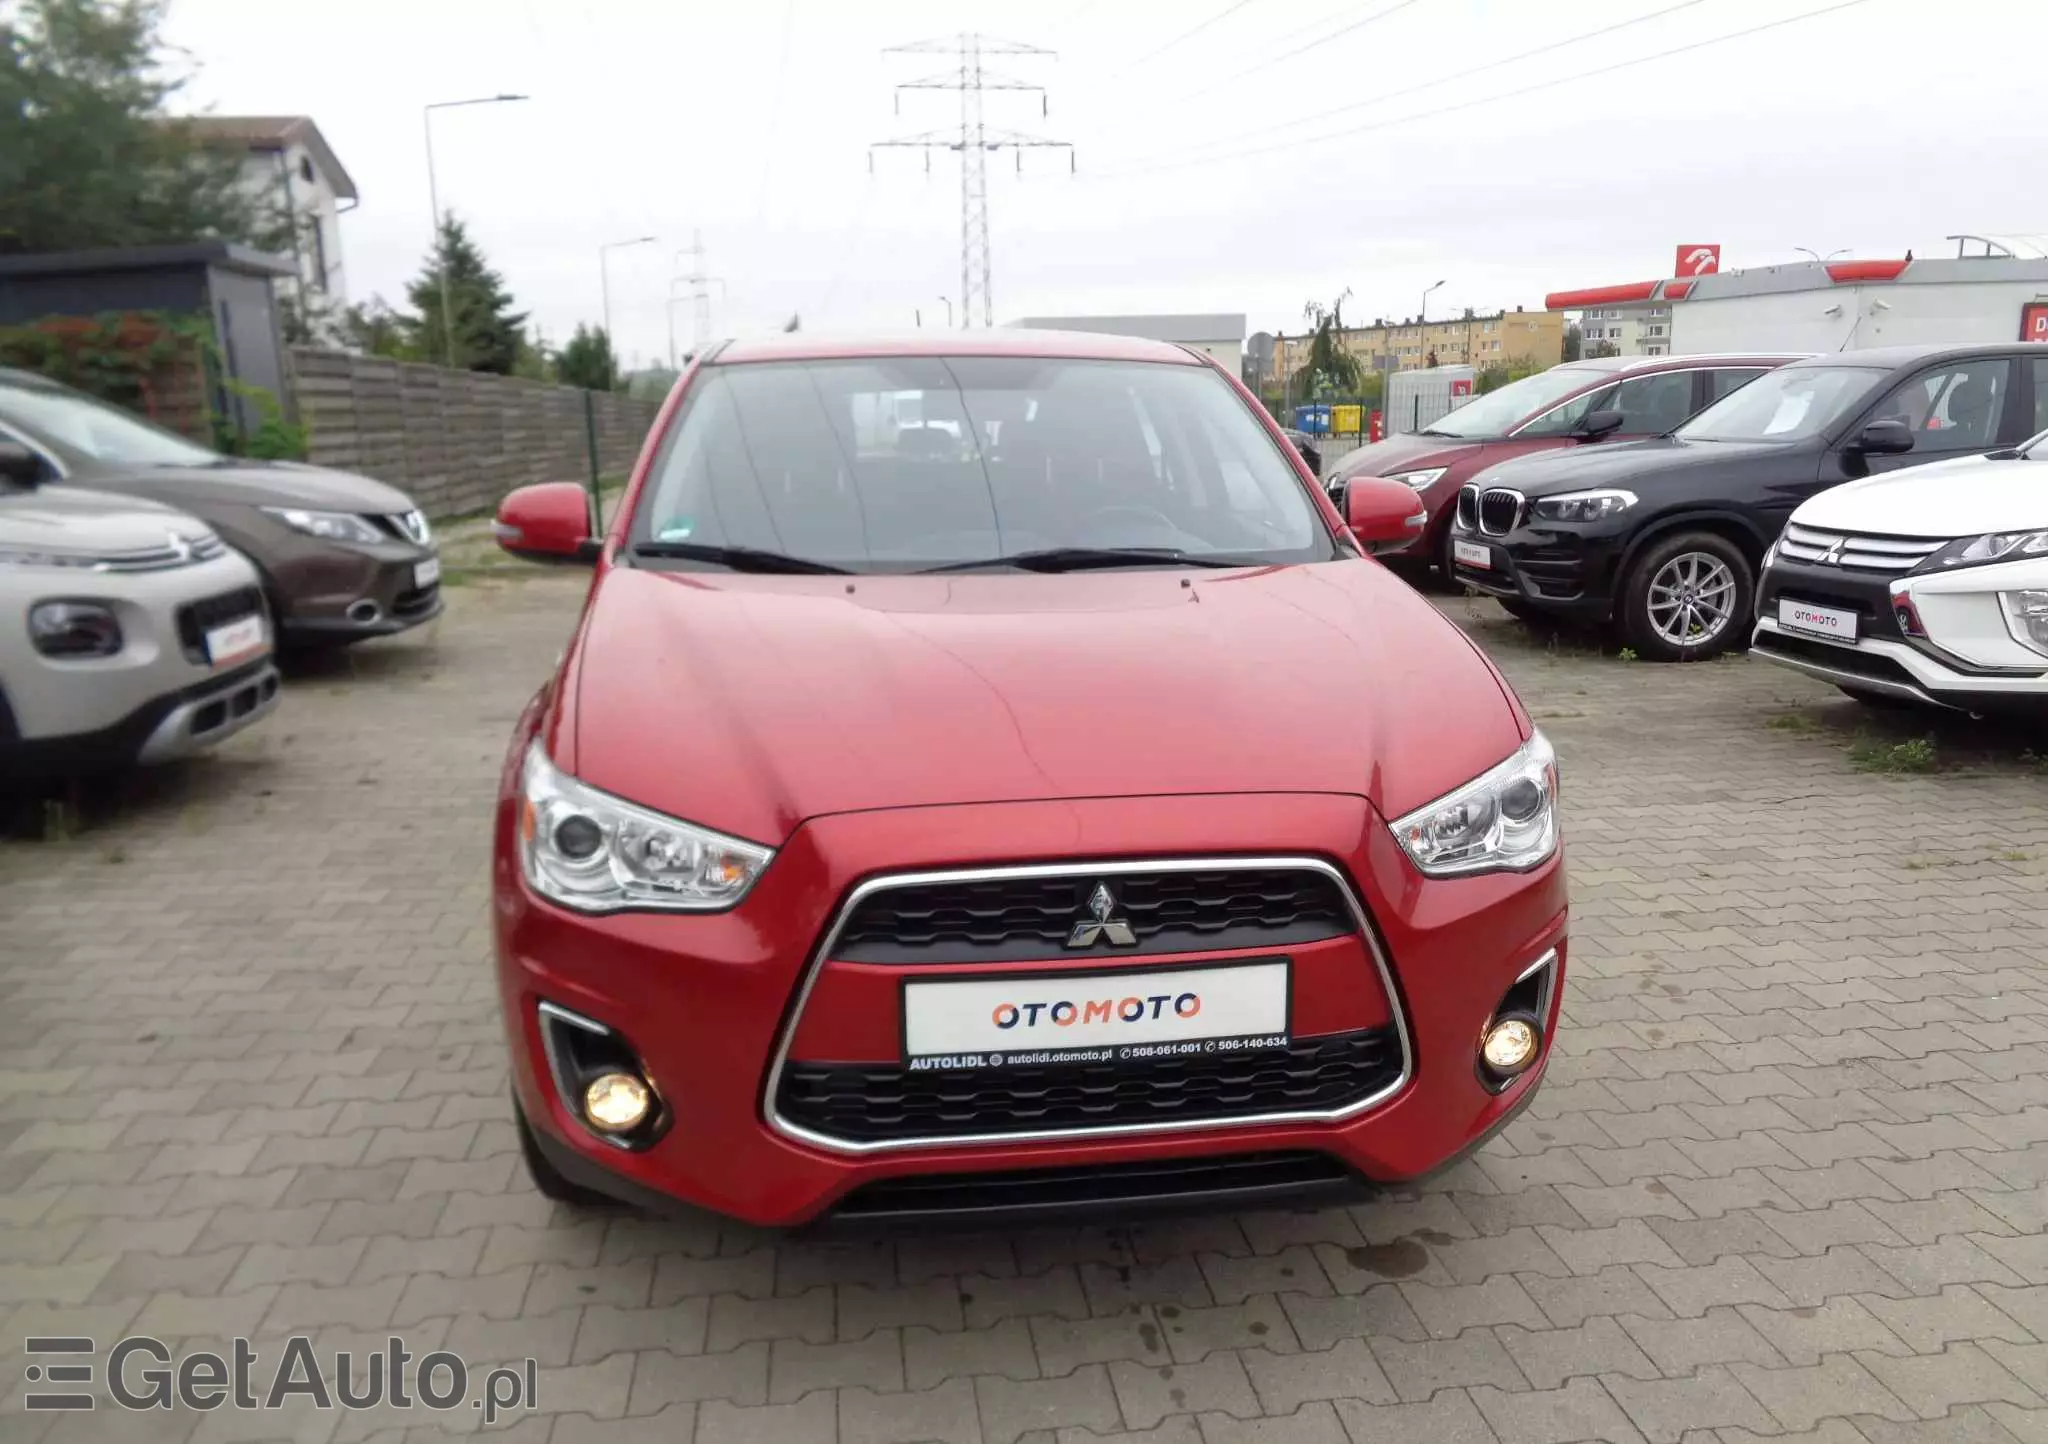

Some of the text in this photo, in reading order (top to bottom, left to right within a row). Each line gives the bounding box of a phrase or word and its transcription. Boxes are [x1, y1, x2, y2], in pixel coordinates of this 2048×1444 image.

[1794, 610, 1837, 626] OTOMOTO
[992, 993, 1201, 1029] OTOMOTO
[910, 1054, 987, 1070] AUTOLIDL
[1007, 1050, 1113, 1062] autolidl.otomoto.pl
